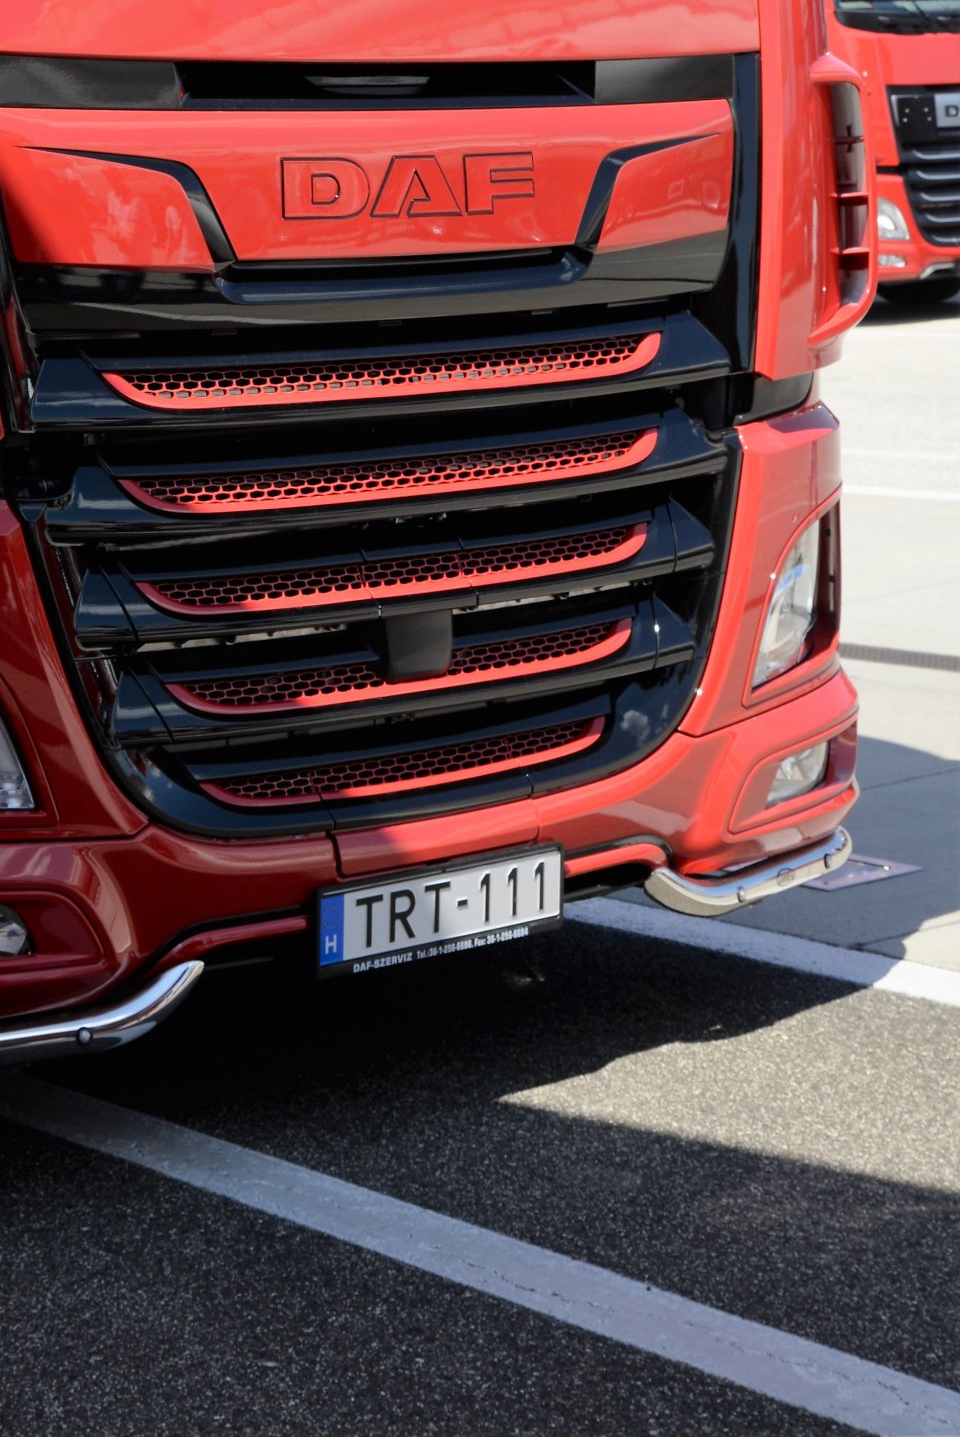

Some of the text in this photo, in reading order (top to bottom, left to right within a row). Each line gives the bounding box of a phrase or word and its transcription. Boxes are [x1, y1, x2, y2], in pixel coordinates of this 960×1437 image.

[280, 151, 535, 220] DAF
[325, 862, 544, 954] H TRT-111
[353, 952, 413, 973] DAF-SZERVIZ
